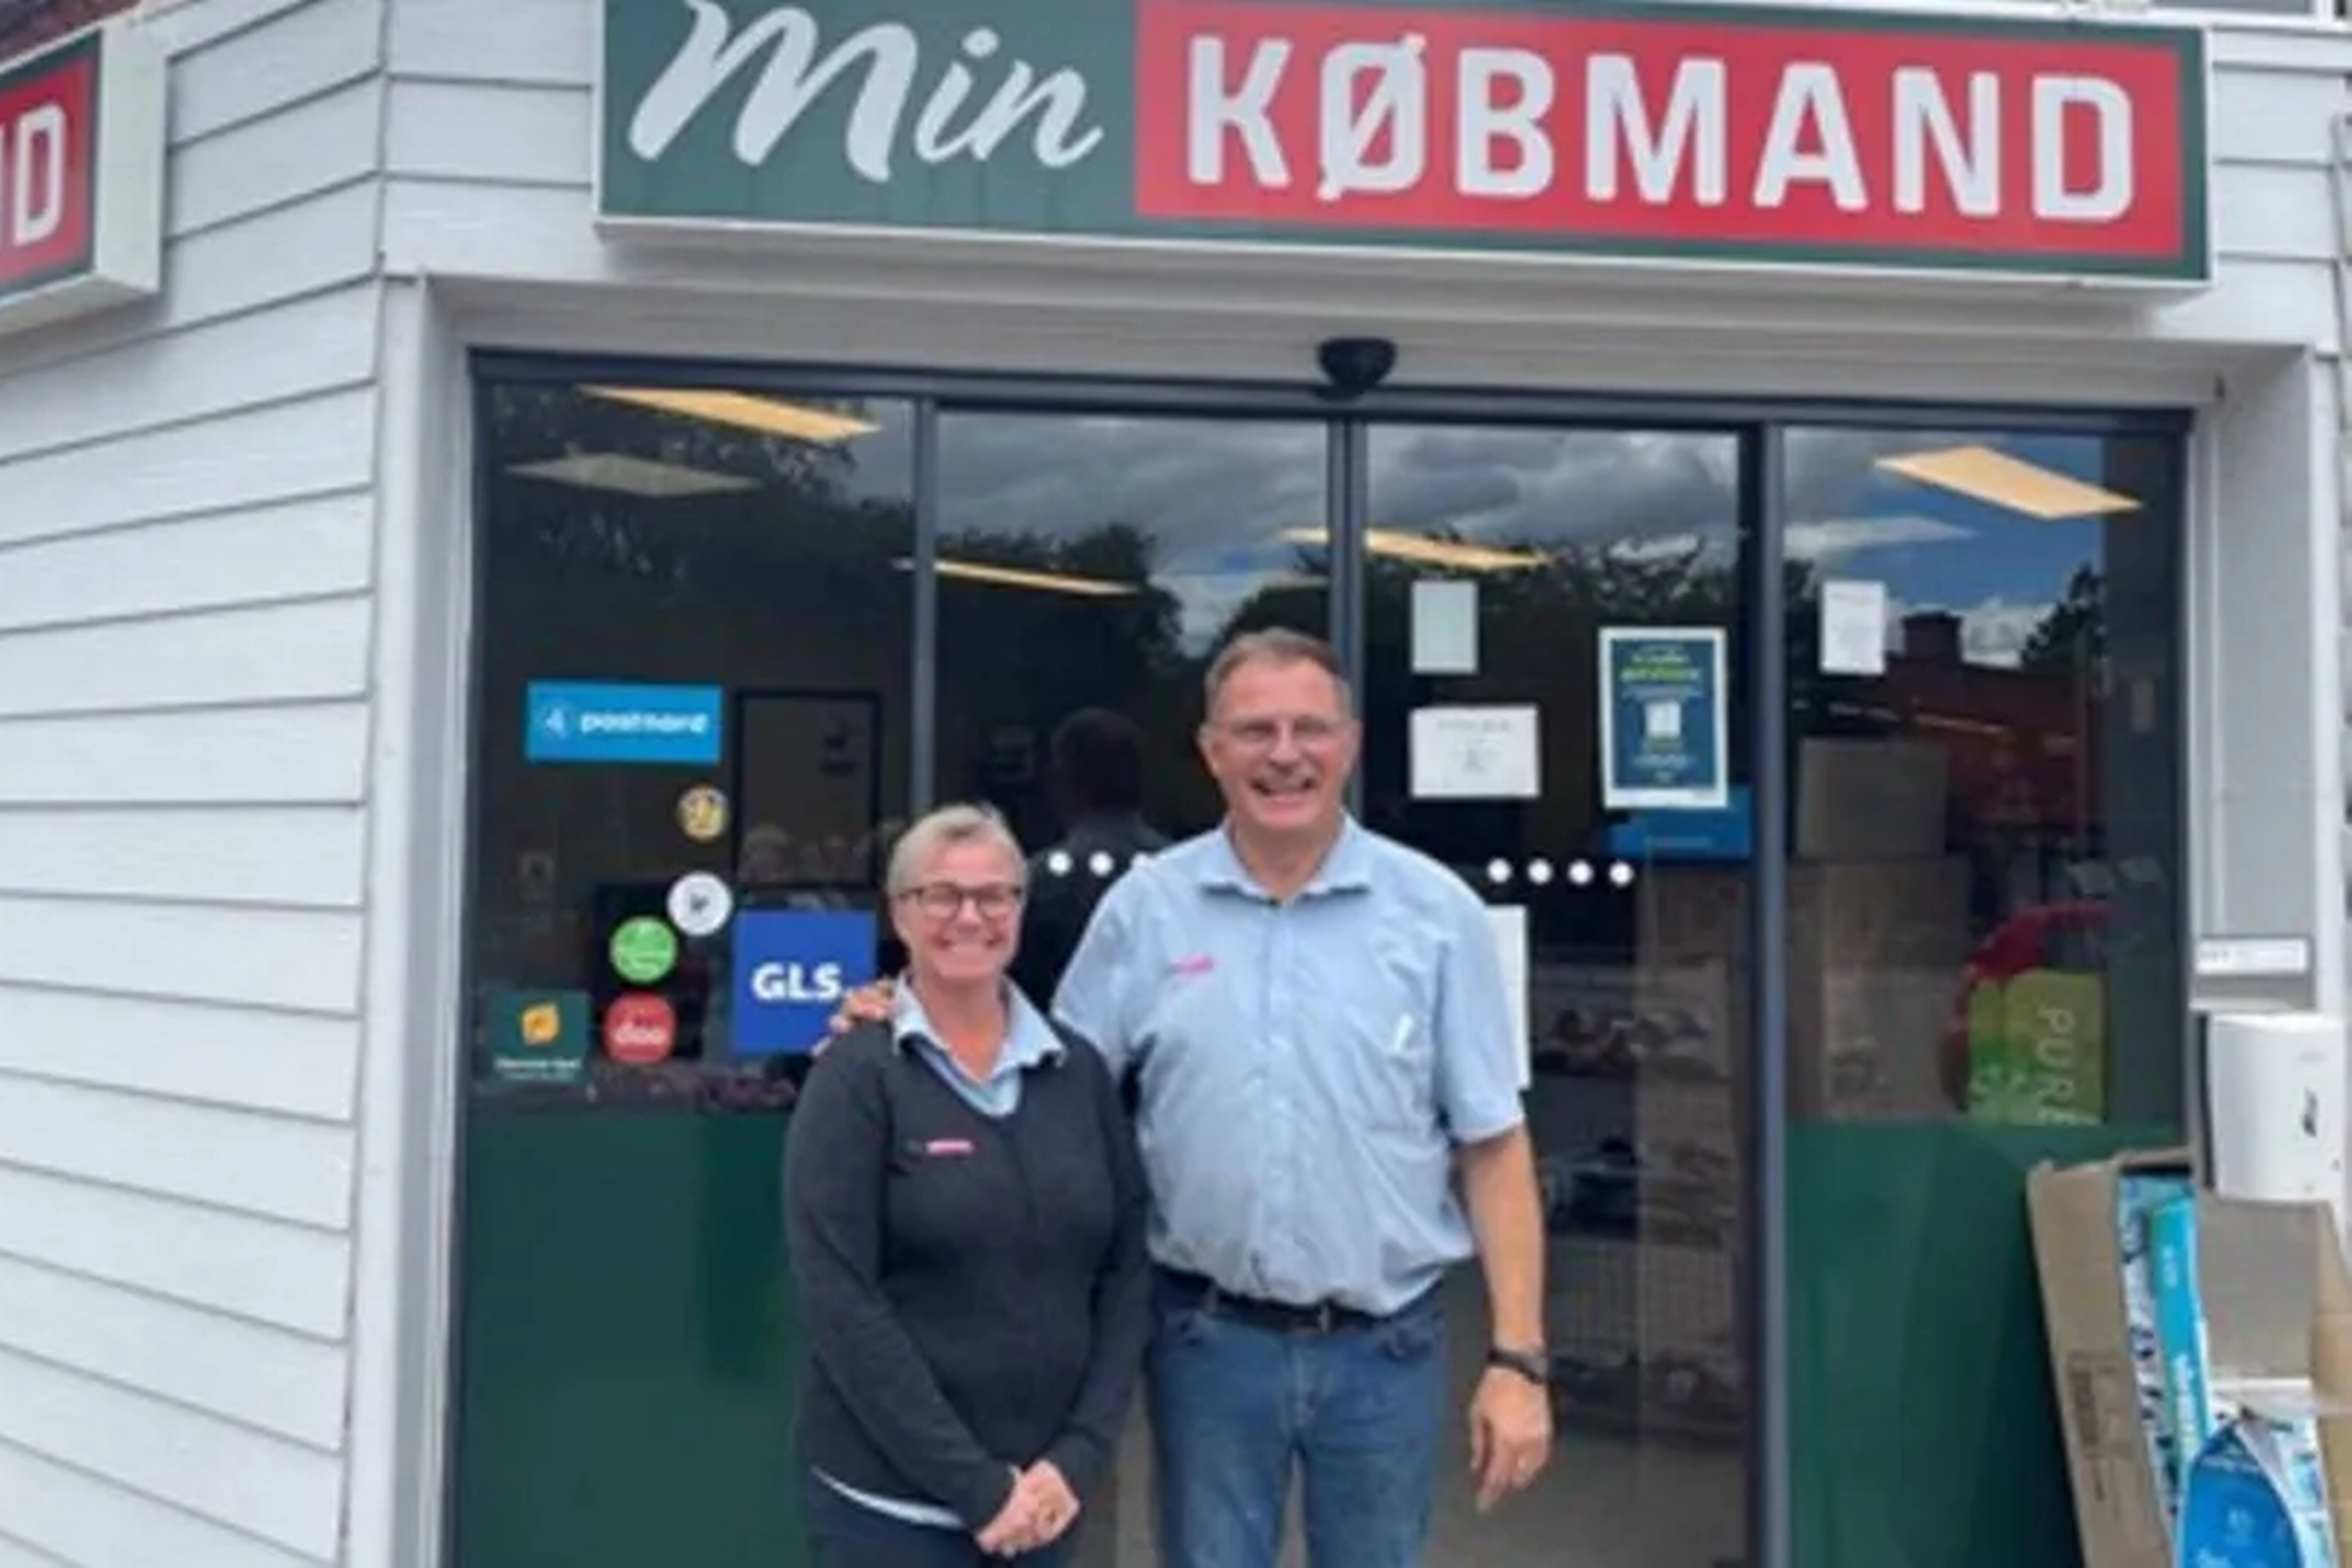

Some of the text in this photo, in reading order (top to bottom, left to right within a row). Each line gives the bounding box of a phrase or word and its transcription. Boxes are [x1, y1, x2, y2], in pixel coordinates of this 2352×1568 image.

[0, 103, 64, 246] D
[628, 0, 2133, 221] Min KØBMAND
[752, 962, 842, 1002] GLS
